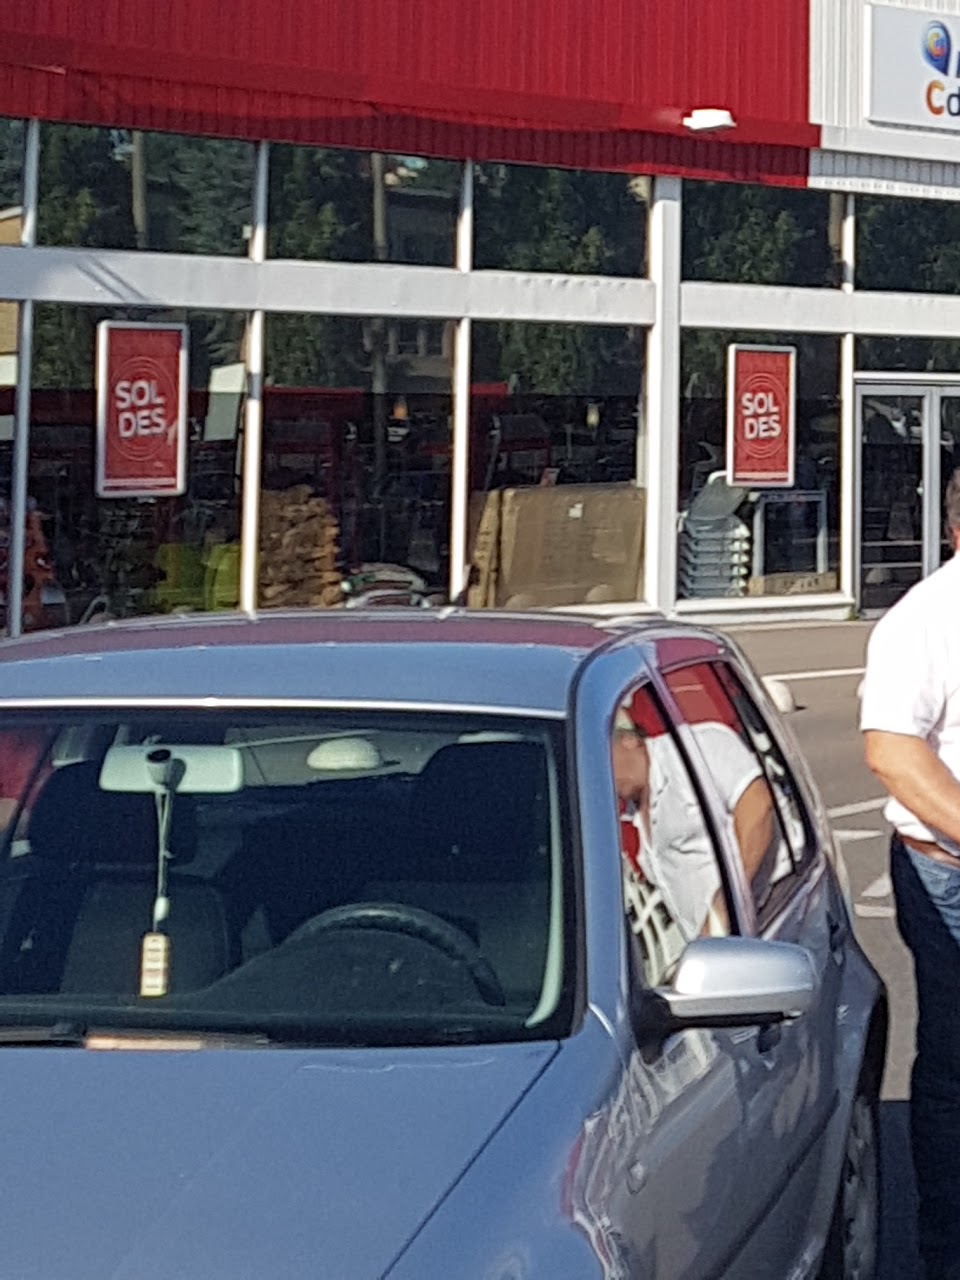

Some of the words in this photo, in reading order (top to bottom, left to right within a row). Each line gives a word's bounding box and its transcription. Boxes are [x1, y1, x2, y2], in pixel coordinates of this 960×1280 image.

[115, 380, 166, 410] SOL
[741, 392, 780, 416] SOL
[118, 408, 167, 438] DES
[744, 415, 782, 440] DES
